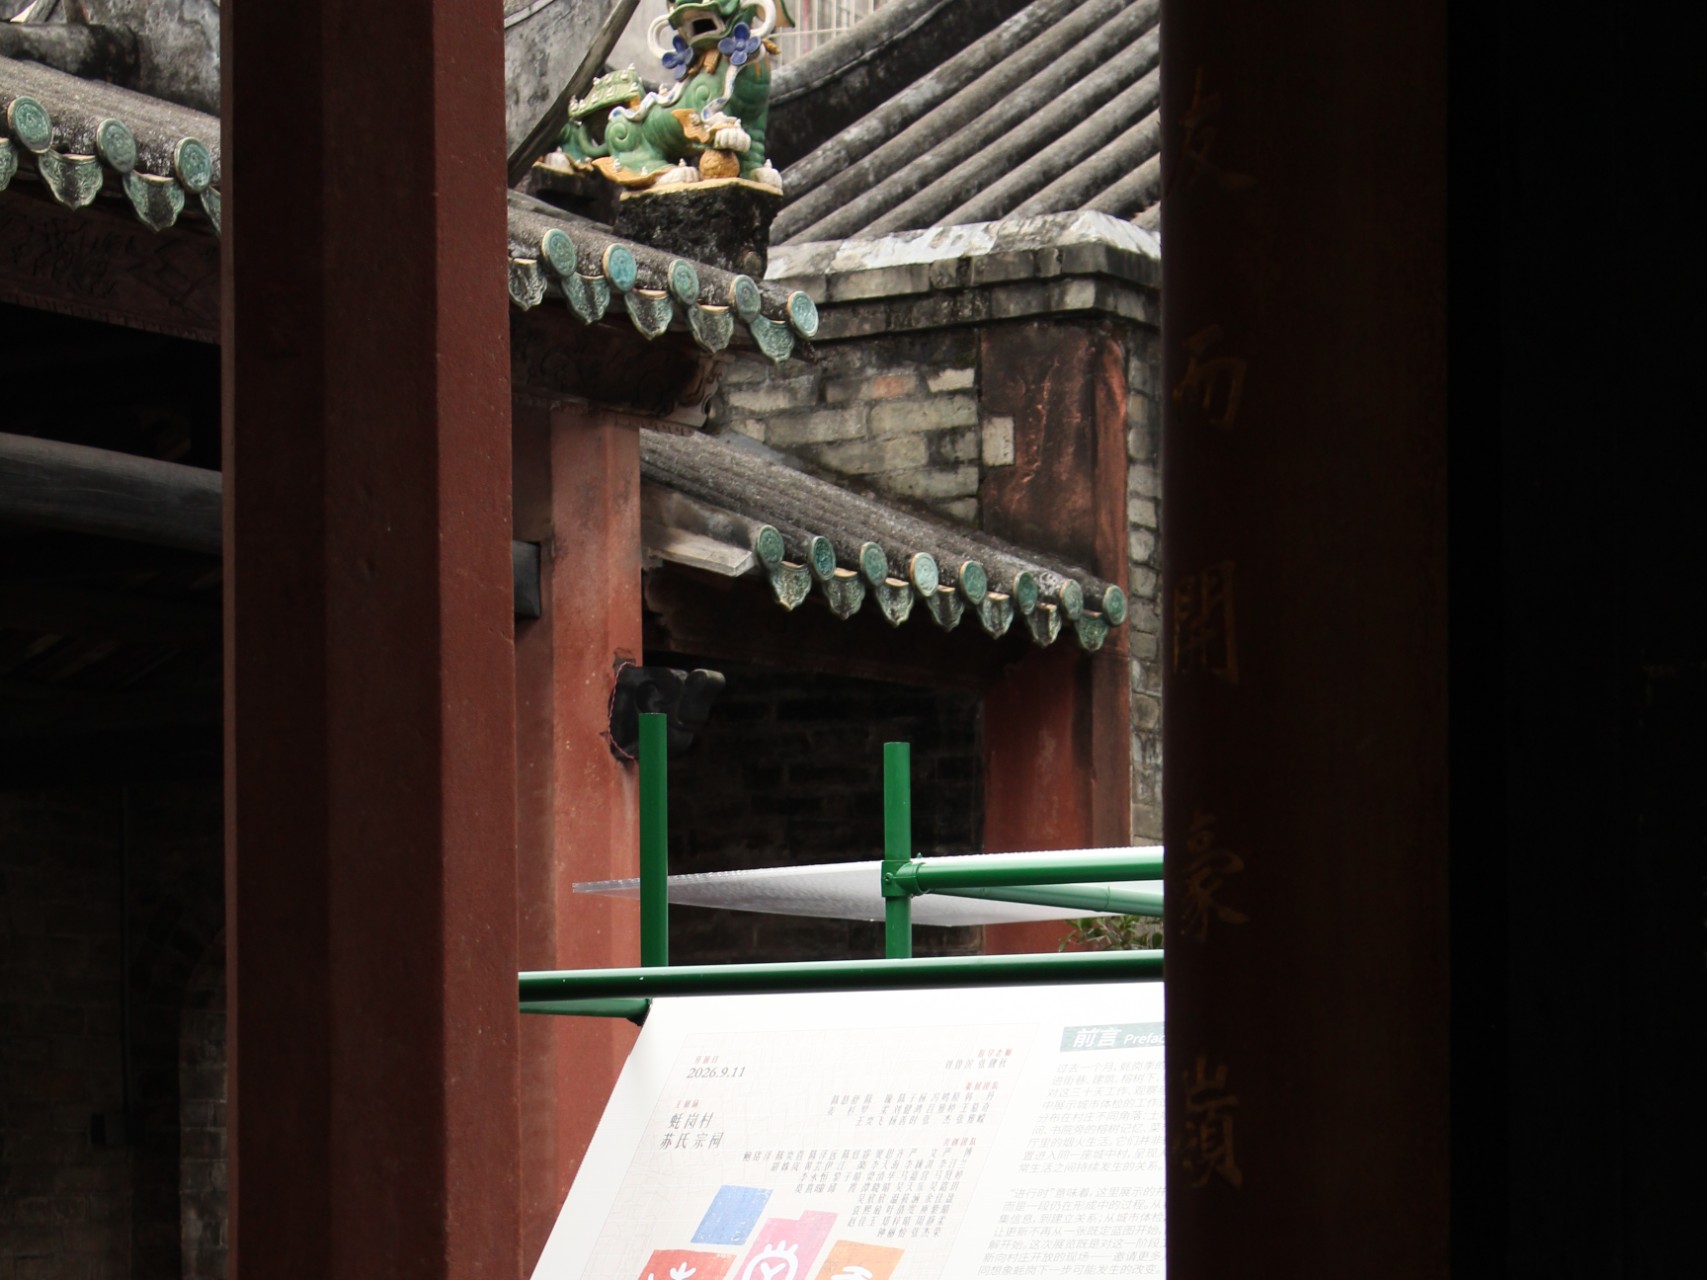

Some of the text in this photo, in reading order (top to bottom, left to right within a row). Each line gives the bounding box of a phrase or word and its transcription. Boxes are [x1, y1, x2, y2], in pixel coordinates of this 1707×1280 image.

[1073, 1028, 1122, 1047] 前言
[686, 1066, 746, 1079] 2026.9.11
[668, 1112, 714, 1129] 蚝岗村
[659, 1132, 724, 1150] 苏氏宗祠
